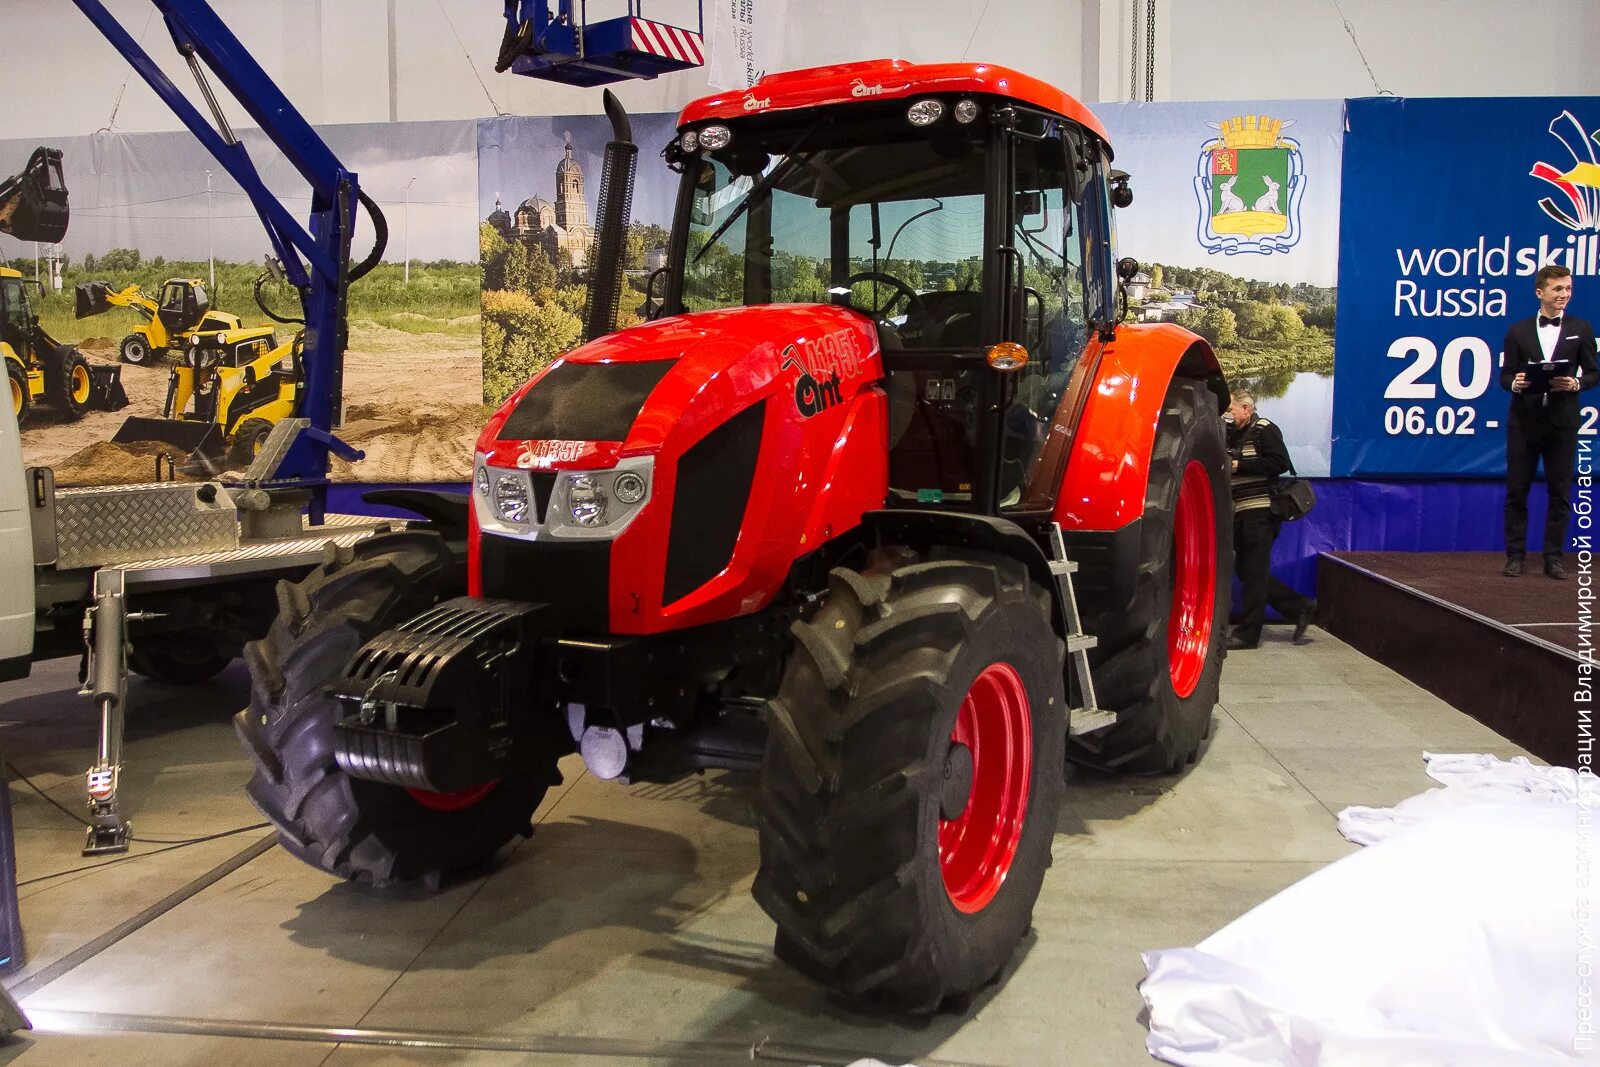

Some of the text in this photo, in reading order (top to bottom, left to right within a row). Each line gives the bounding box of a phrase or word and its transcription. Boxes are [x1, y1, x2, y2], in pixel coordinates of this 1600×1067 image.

[1396, 234, 1600, 276] world skill
[1394, 278, 1507, 317] Russia
[1384, 405, 1475, 435] 06.02
